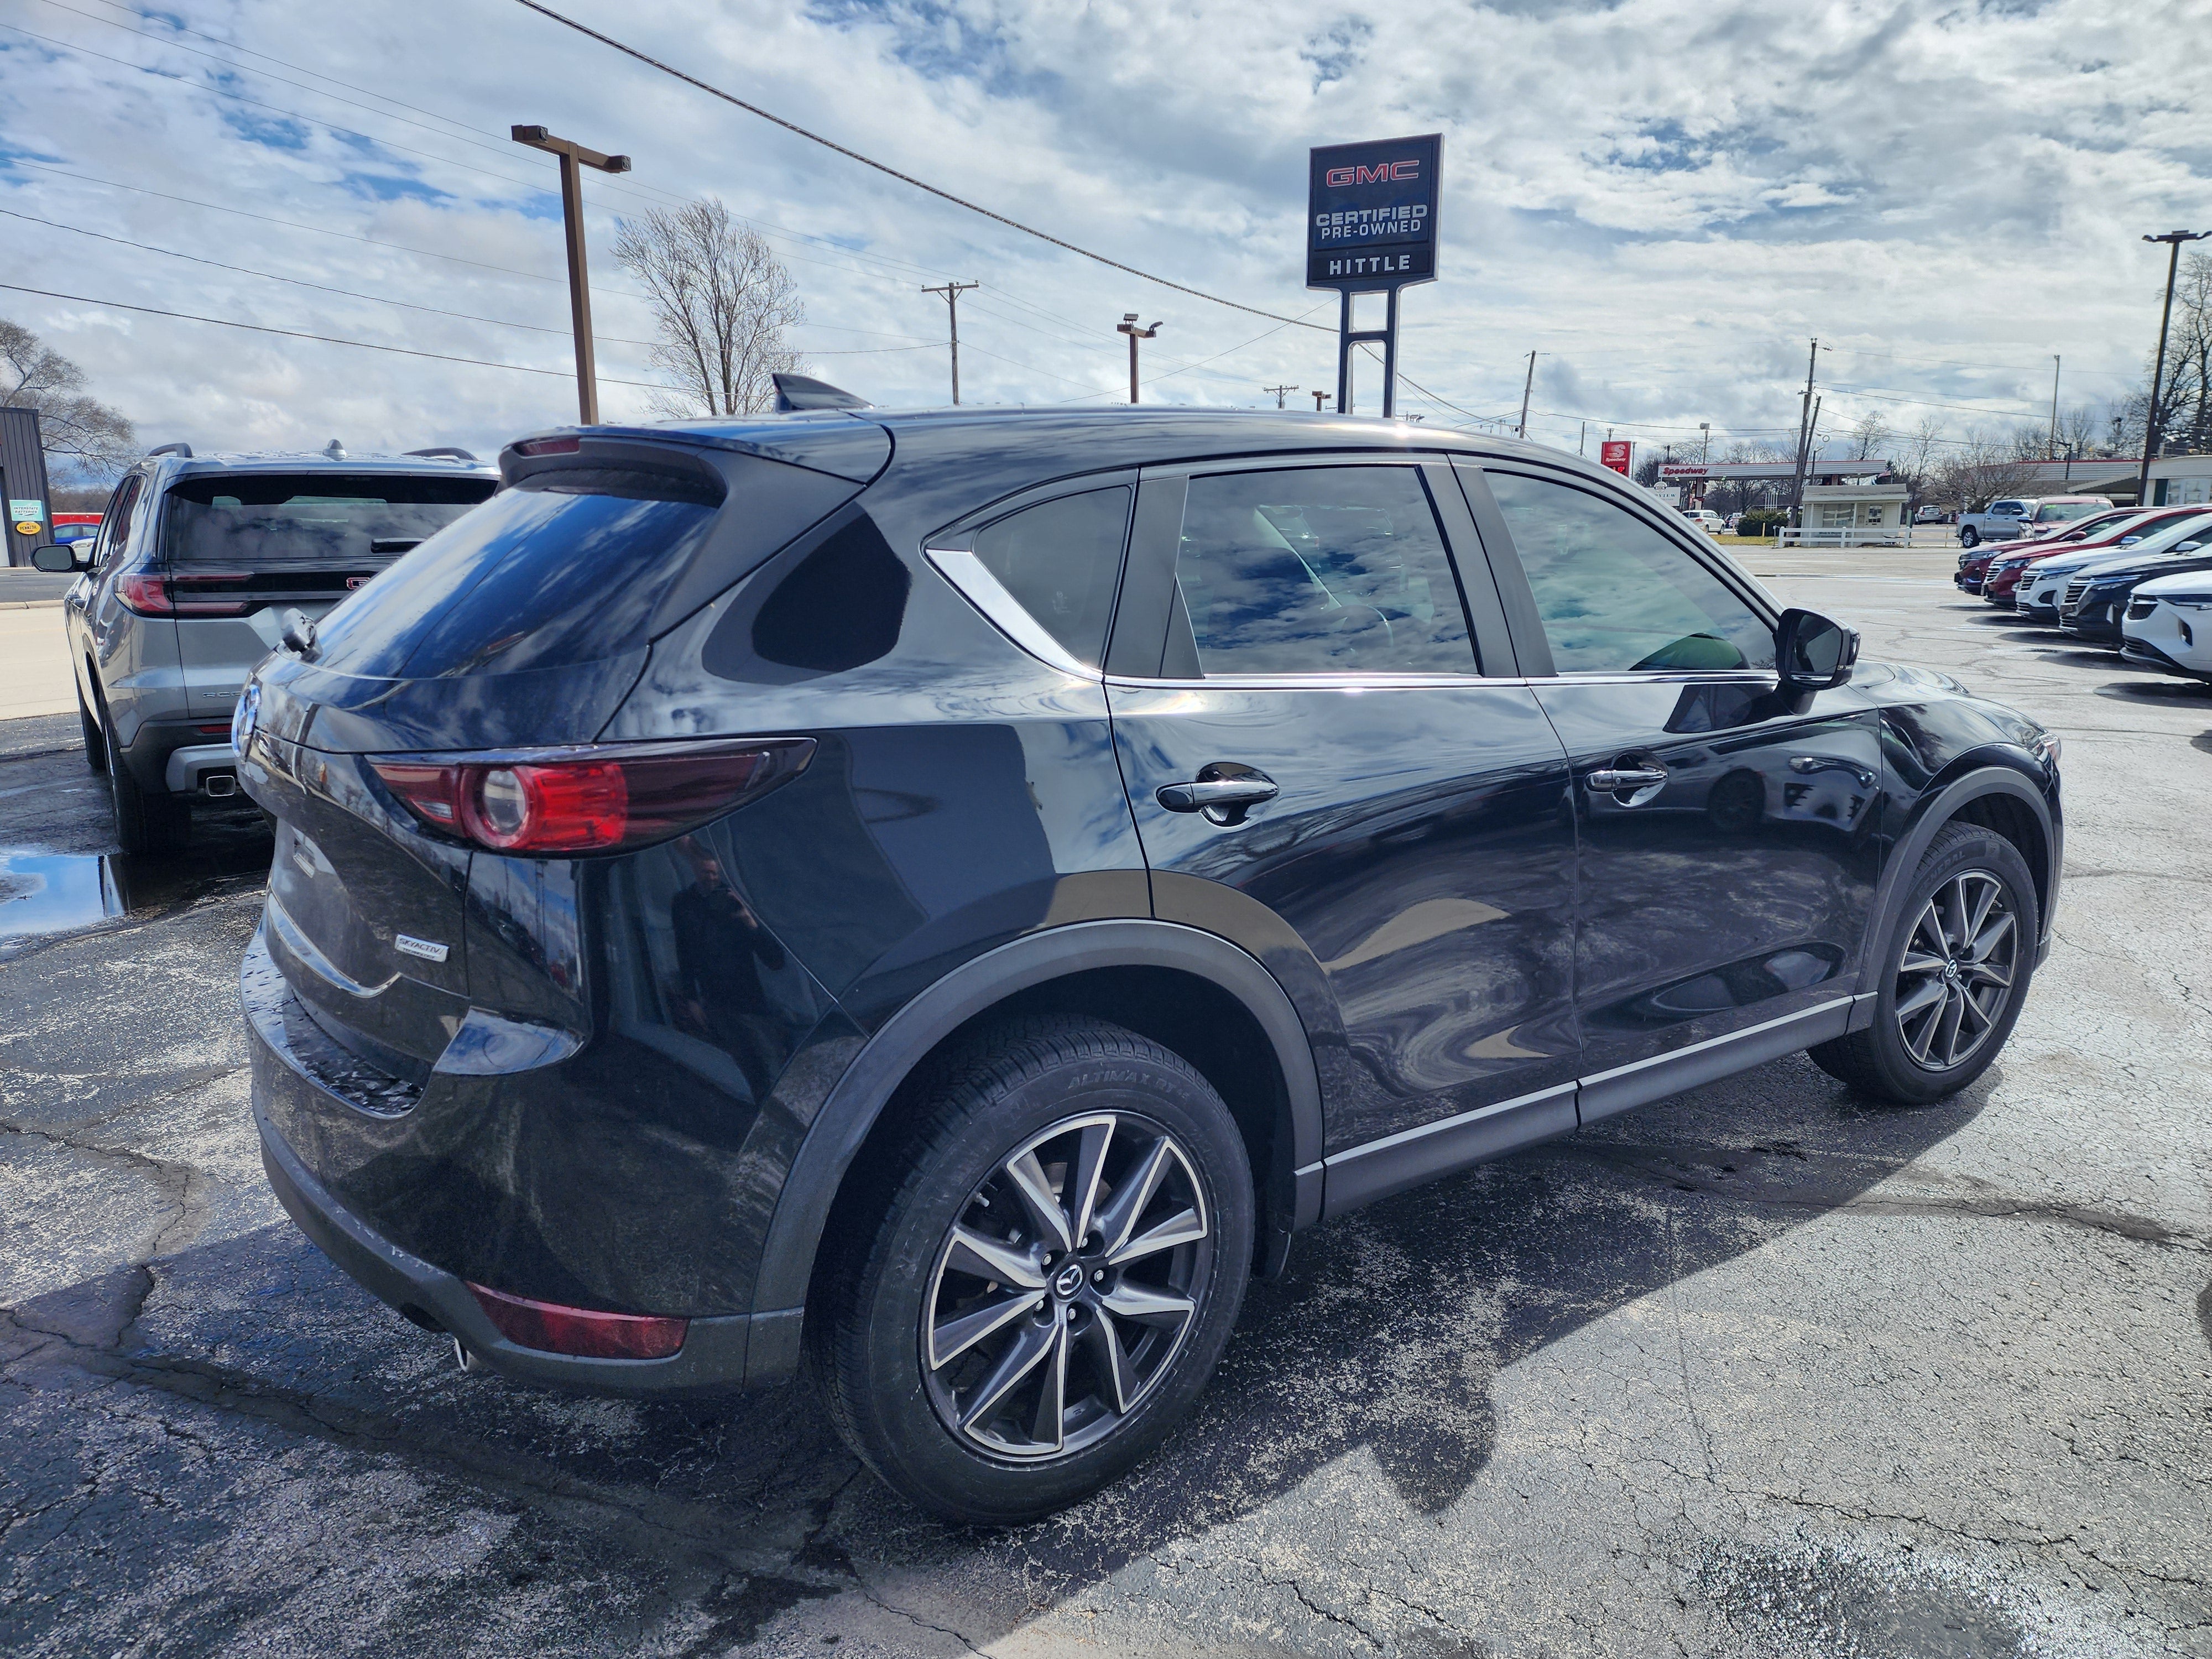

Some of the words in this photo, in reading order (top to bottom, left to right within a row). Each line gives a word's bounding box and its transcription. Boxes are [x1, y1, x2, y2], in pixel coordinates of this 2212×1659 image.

[1327, 160, 1420, 187] GMC
[1316, 205, 1427, 226] CERTIFIED
[1322, 220, 1421, 239] PRE-OWNED
[1329, 255, 1410, 275] HITTLE
[1663, 467, 1709, 476] Speedway
[399, 938, 440, 953] SKYACTIV
[1068, 1070, 1150, 1089] ALTIMAX
